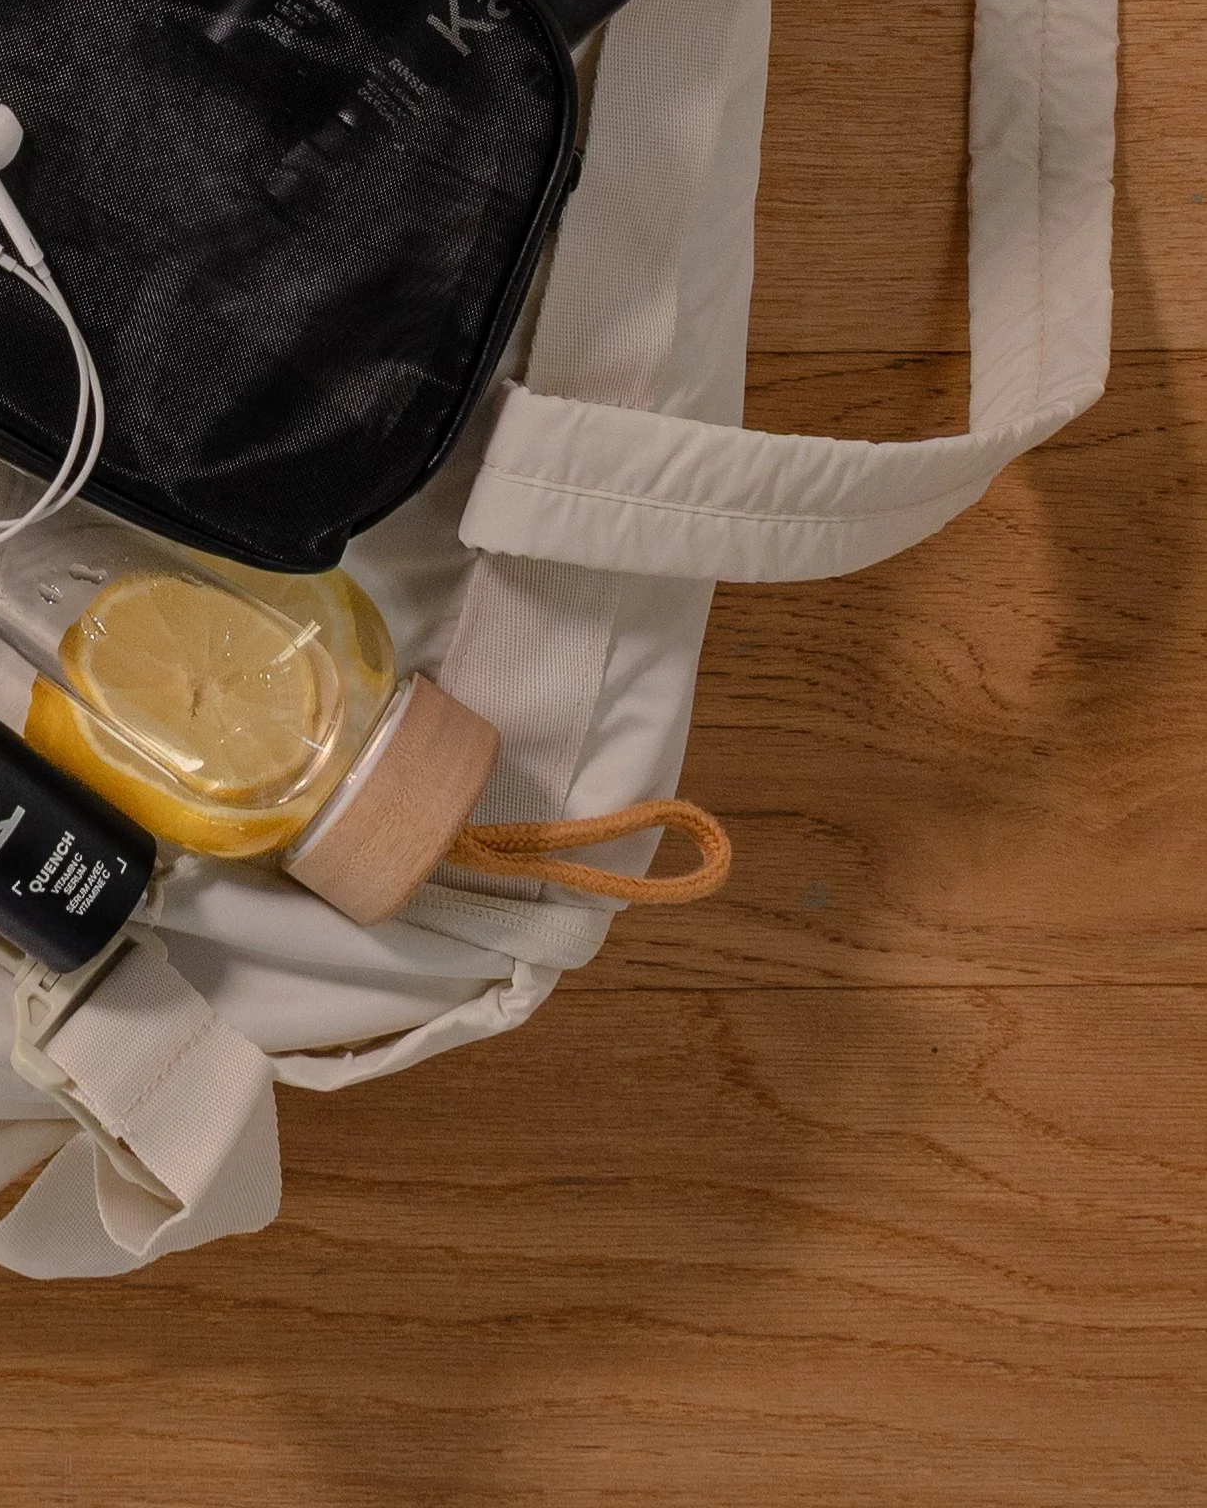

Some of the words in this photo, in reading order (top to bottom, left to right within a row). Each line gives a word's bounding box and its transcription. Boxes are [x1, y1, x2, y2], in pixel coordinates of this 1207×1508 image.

[28, 830, 76, 893] QUENCH
[50, 859, 79, 894] VITAMIN
[74, 852, 83, 863] C
[63, 863, 88, 895] SERUM
[86, 859, 105, 884] AVEC
[75, 876, 107, 916] VITAMINE
[101, 869, 111, 880] C
